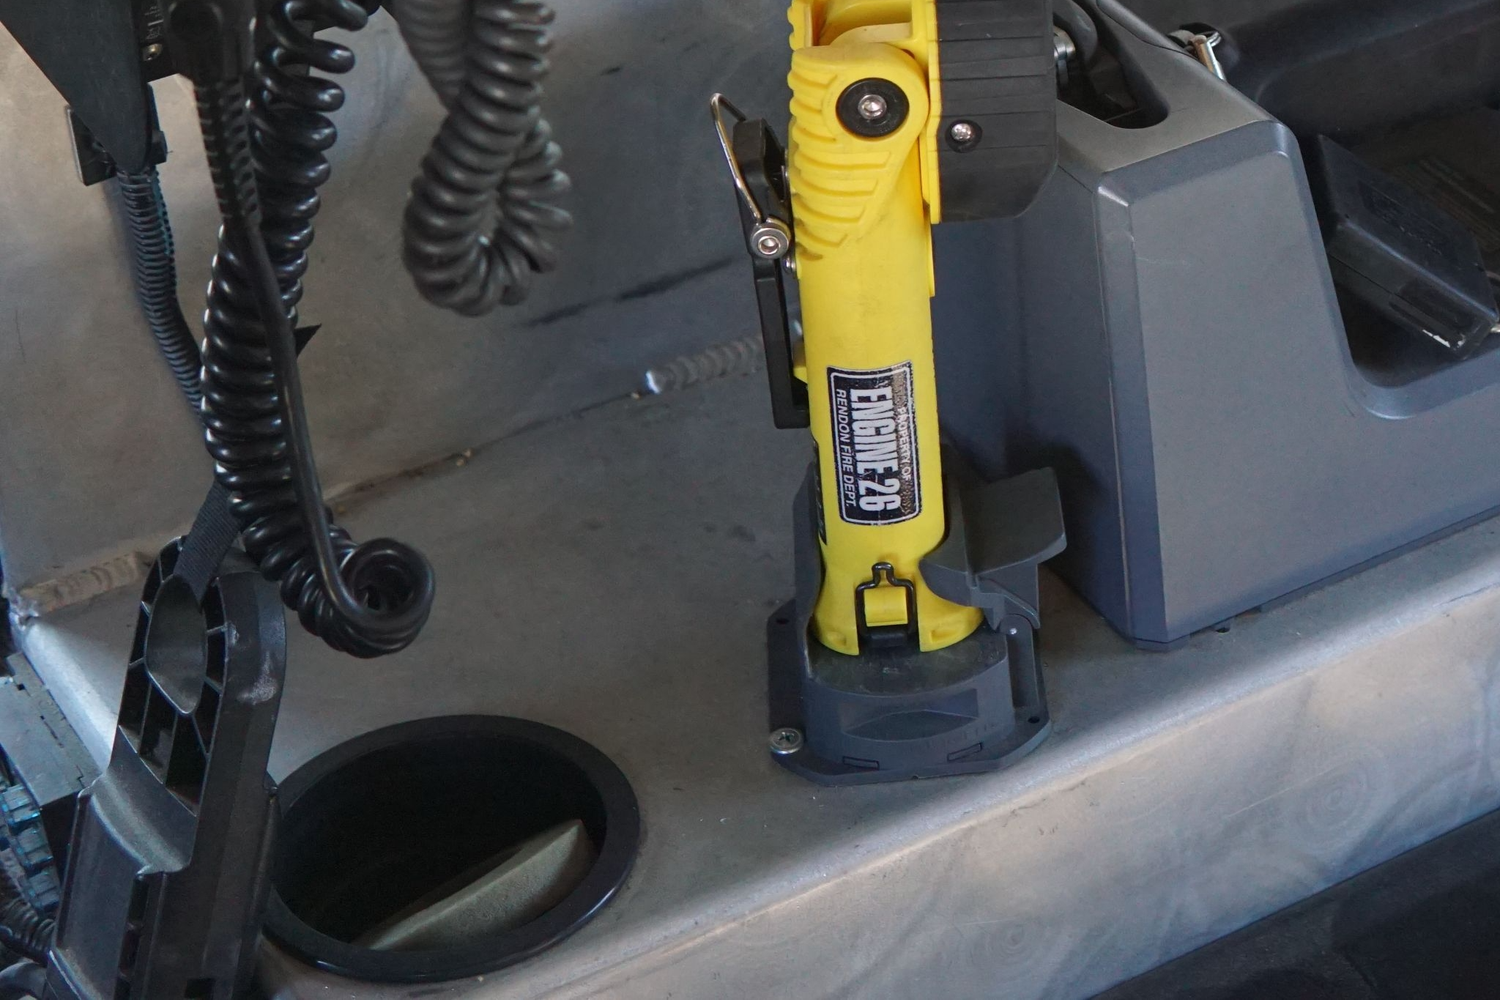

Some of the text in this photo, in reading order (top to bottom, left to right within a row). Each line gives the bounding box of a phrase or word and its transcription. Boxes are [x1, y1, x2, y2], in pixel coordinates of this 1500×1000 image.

[836, 389, 856, 507] RENDON FIRE DEPT.
[850, 387, 901, 512] ENGINE 26
[898, 406, 912, 481] PROPERTY OF
